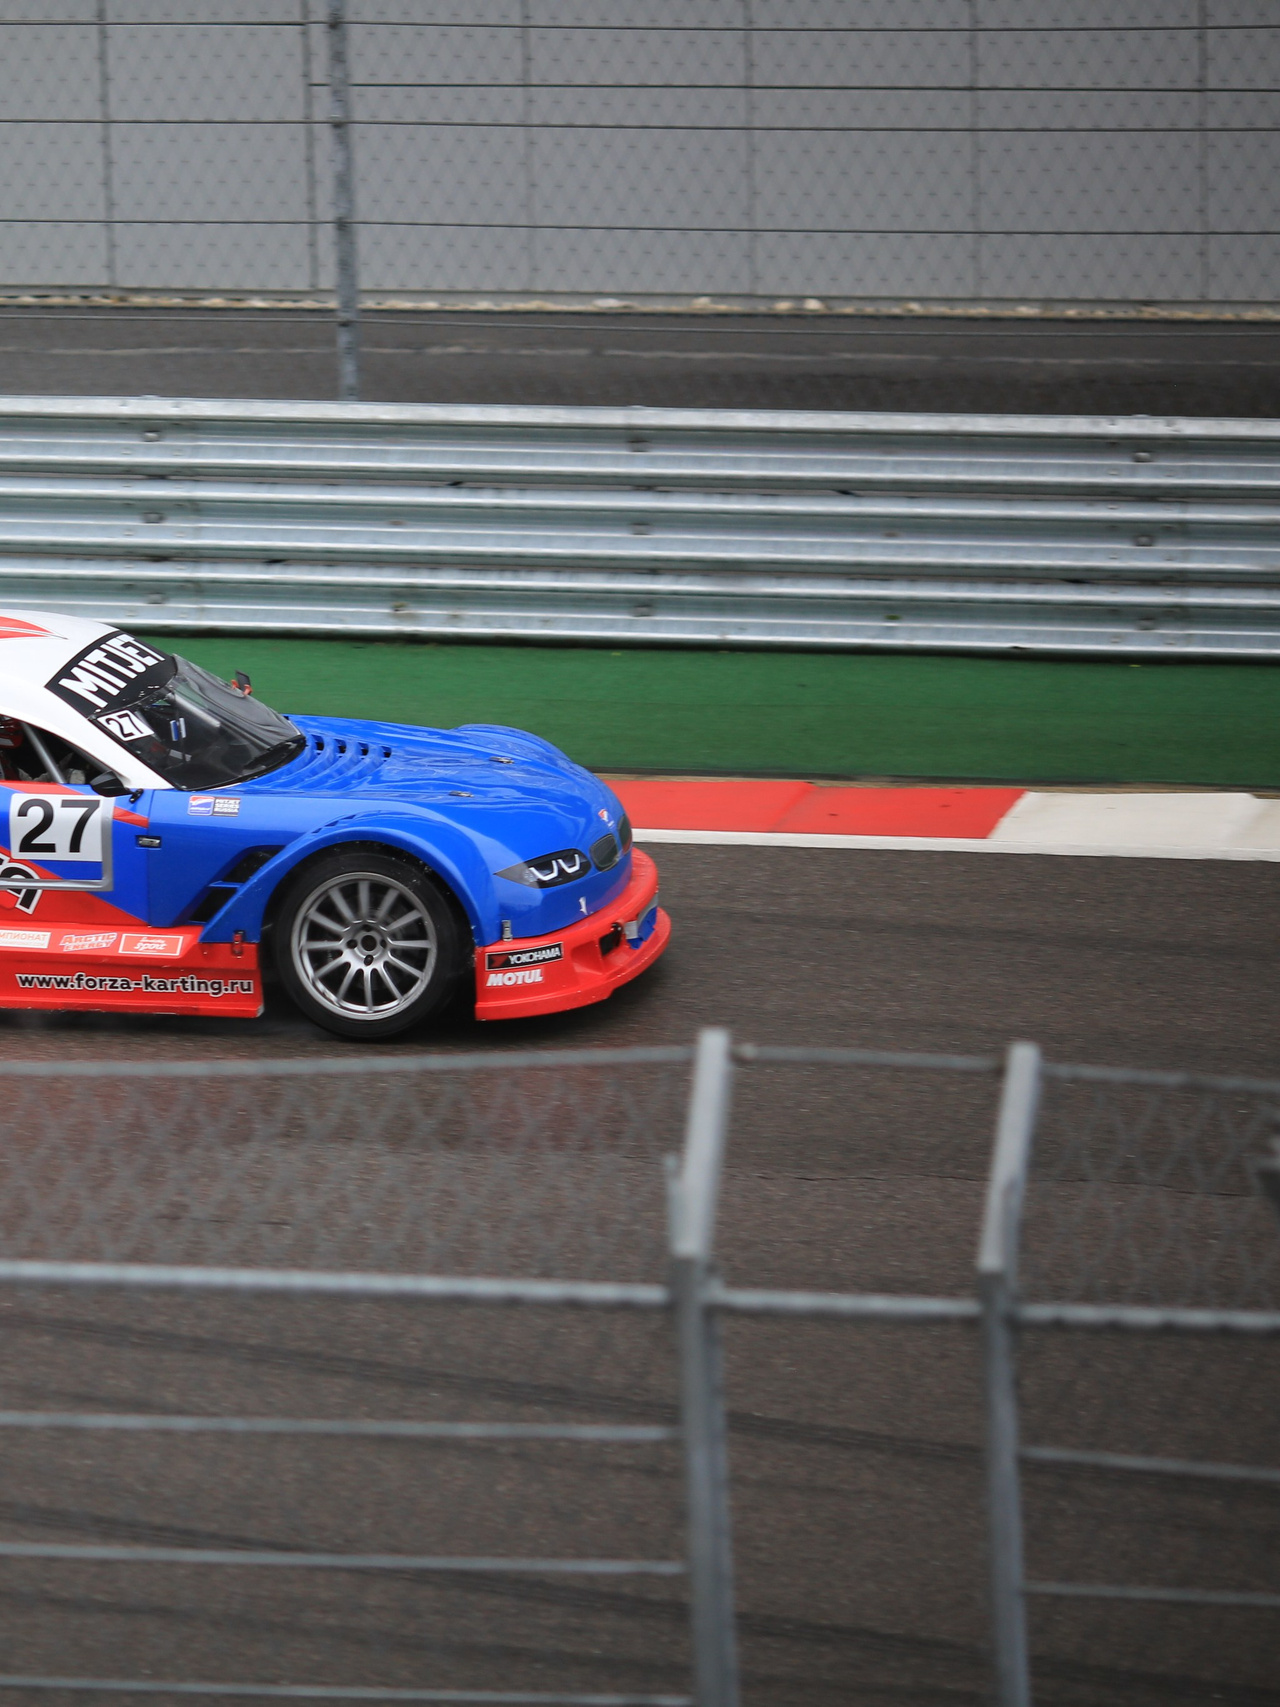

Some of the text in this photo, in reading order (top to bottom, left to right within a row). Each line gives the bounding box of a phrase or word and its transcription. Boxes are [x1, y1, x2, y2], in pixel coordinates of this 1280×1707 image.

[58, 633, 166, 708] MITJET
[105, 712, 144, 738] 27
[17, 798, 101, 853] 27
[508, 947, 560, 965] YOKOHAMA
[16, 973, 253, 996] www.forza-karting.ru
[486, 969, 543, 987] MOTUL
